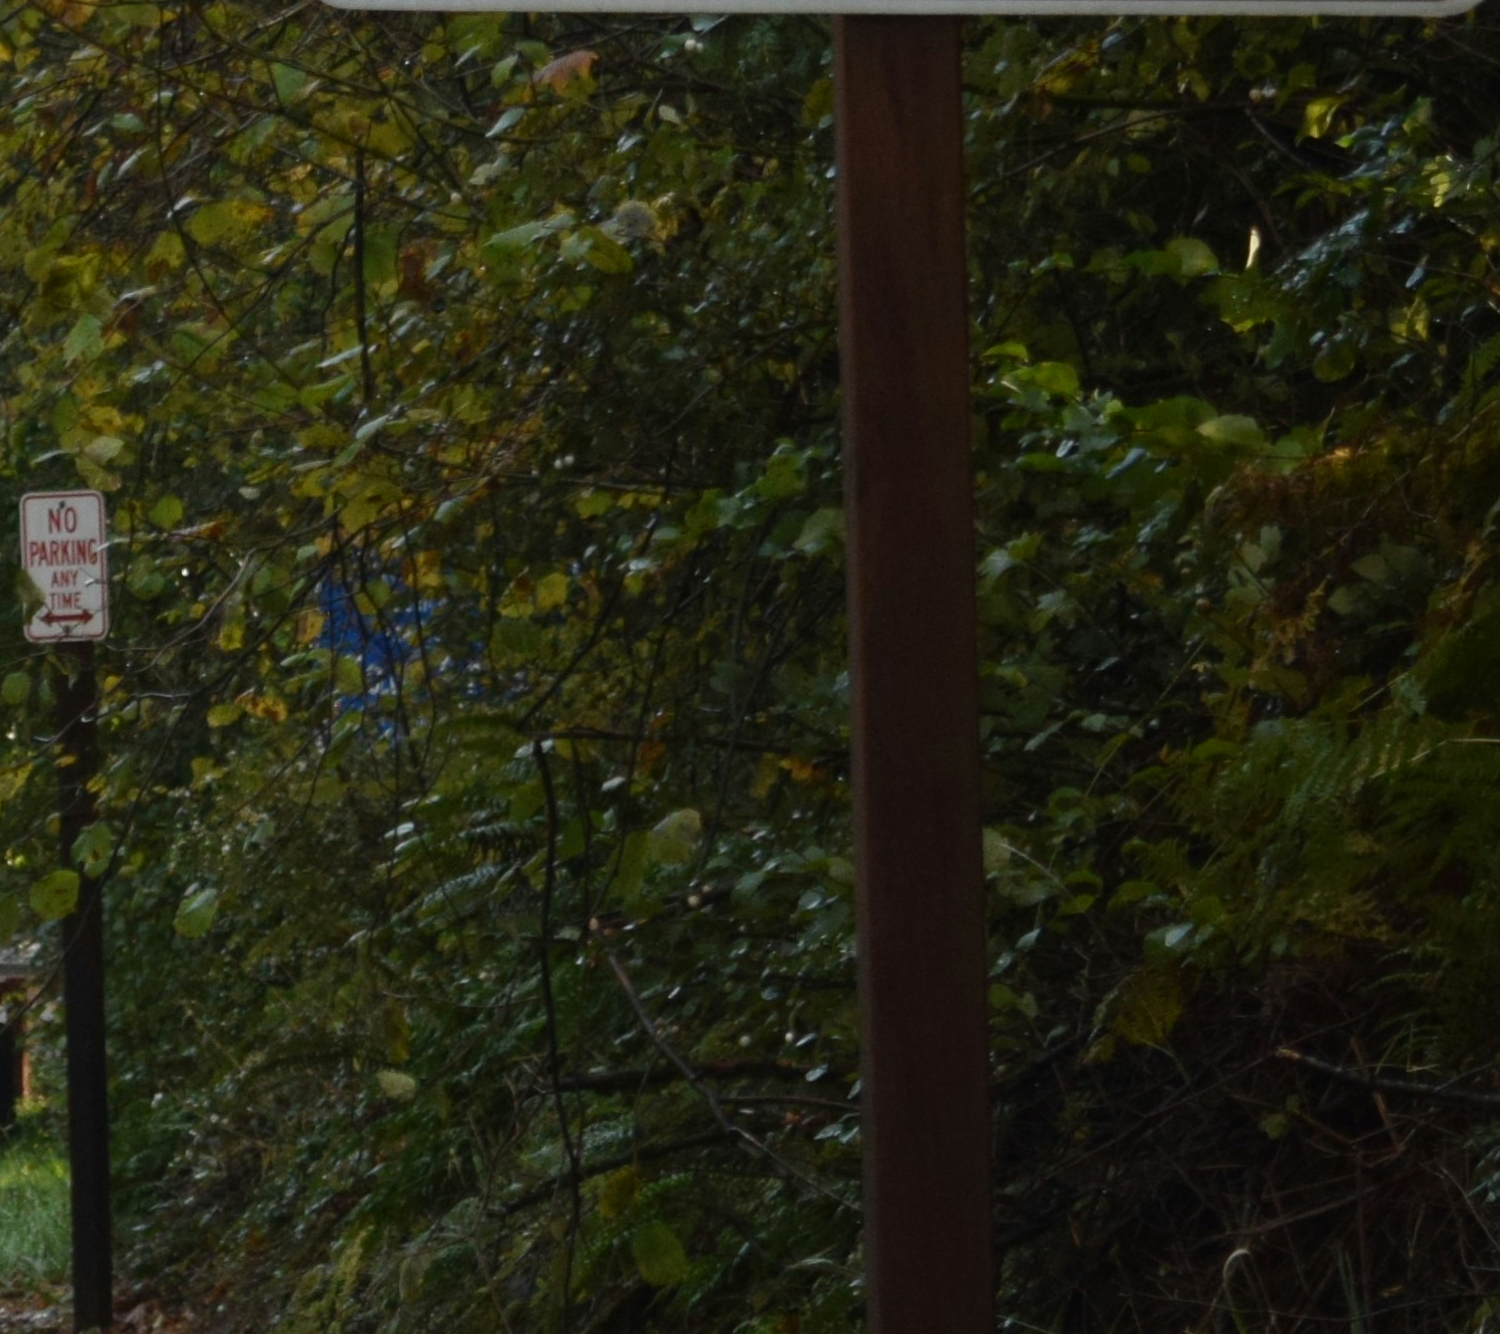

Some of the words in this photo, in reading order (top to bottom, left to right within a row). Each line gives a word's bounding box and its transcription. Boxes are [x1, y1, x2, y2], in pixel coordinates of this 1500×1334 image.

[48, 507, 77, 534] NO
[30, 539, 98, 566] PARKING
[52, 570, 79, 588] ANY
[49, 592, 82, 610] TIME
